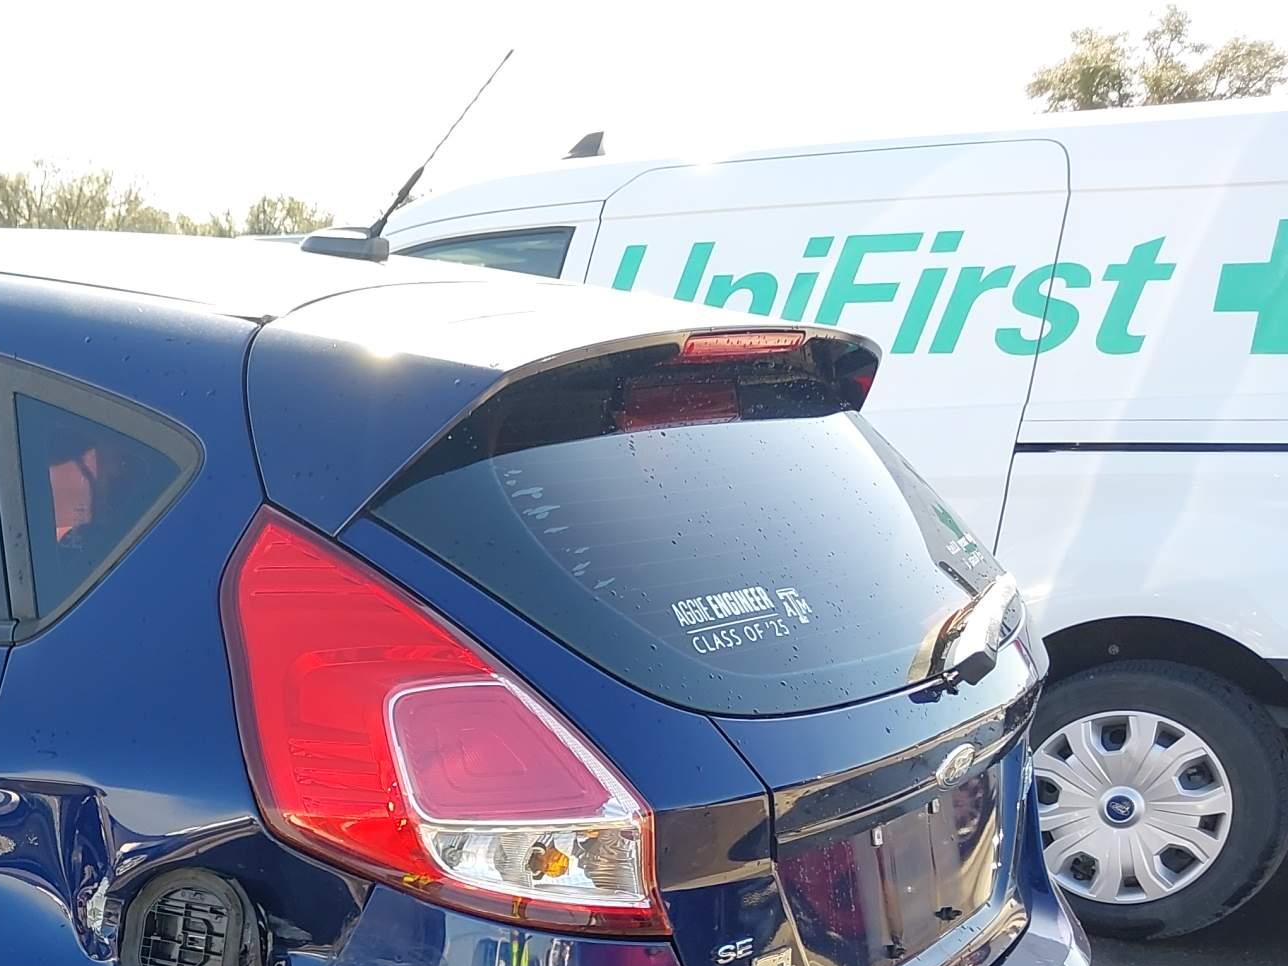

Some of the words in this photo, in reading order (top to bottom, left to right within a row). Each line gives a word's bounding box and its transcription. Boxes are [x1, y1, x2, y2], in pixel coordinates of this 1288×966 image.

[671, 596, 715, 627] AGGIE
[706, 586, 776, 619] ENGINEER
[692, 628, 743, 654] CLASS
[744, 623, 763, 643] OF
[766, 618, 791, 637] '25
[716, 937, 754, 965] SE
